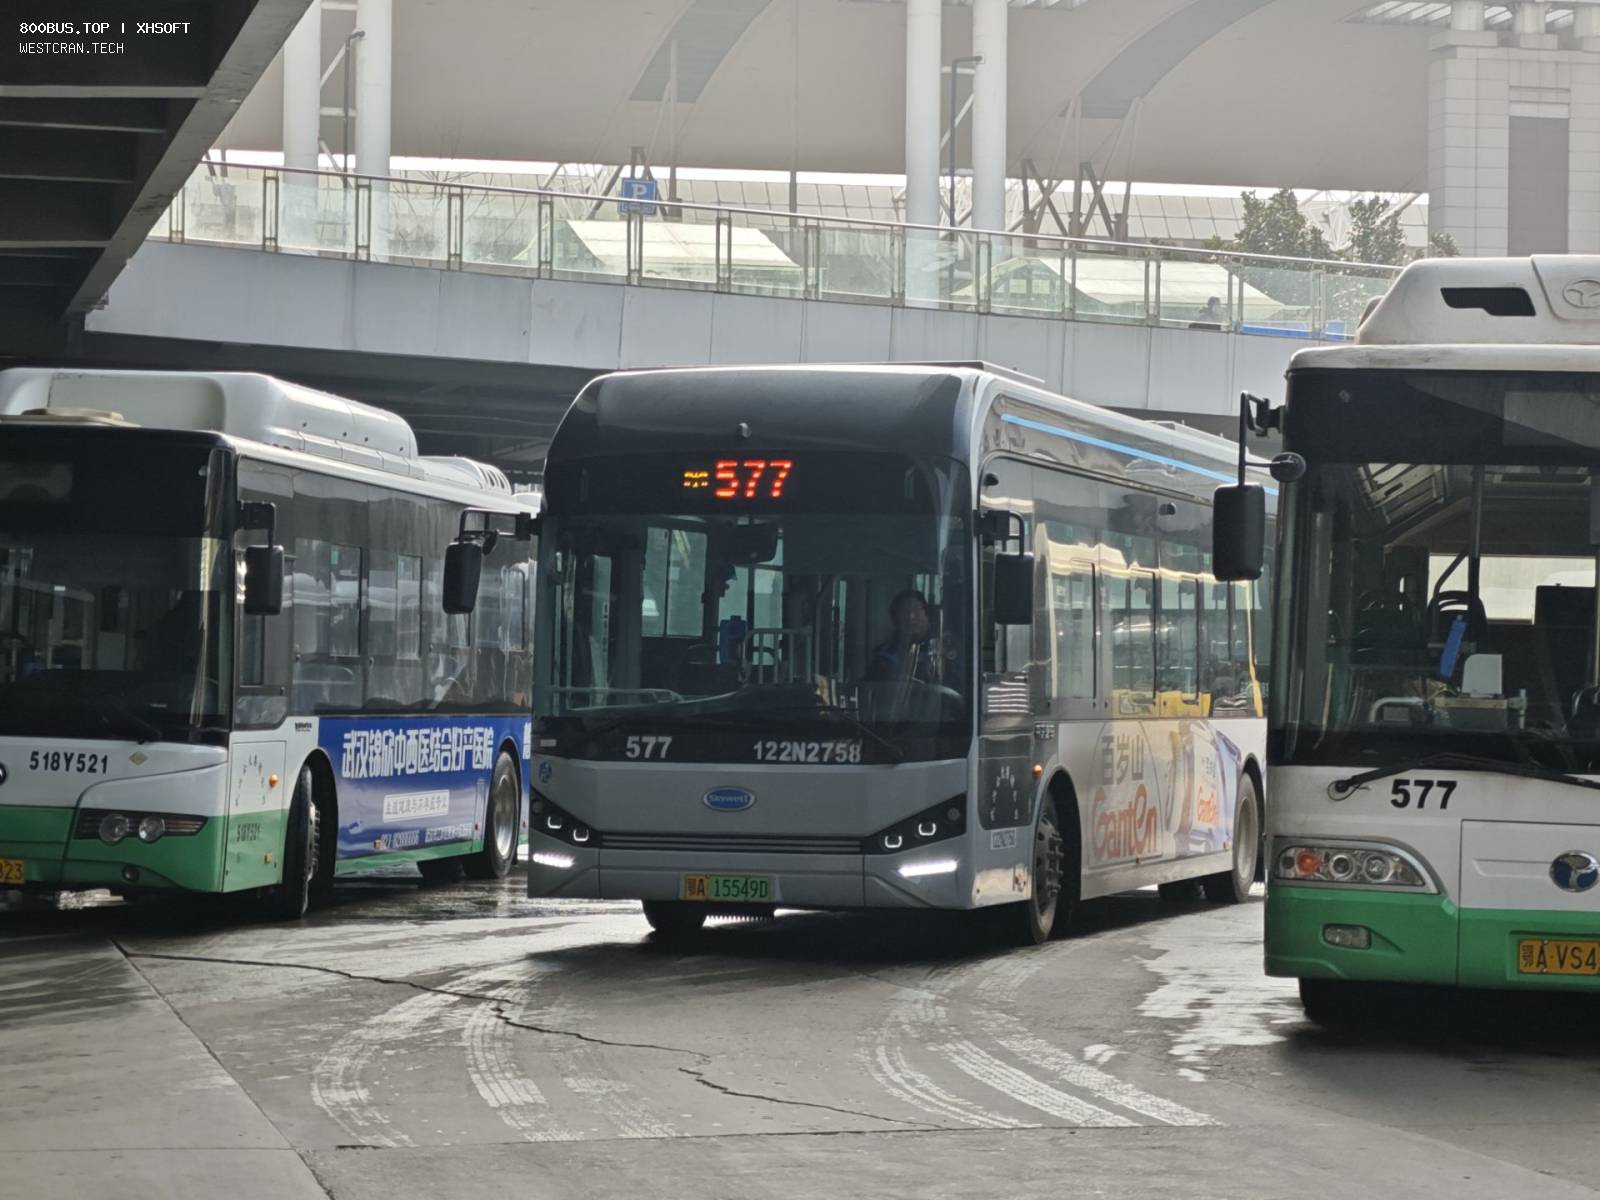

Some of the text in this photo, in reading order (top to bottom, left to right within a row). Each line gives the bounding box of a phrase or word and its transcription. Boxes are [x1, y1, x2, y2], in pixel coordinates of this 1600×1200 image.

[631, 184, 647, 201] P
[716, 460, 792, 498] 577
[626, 736, 673, 759] 577
[753, 740, 862, 763] 122N2758
[1102, 733, 1144, 785] 百岁山
[29, 751, 108, 775] 518Y521
[1390, 779, 1457, 809] 577
